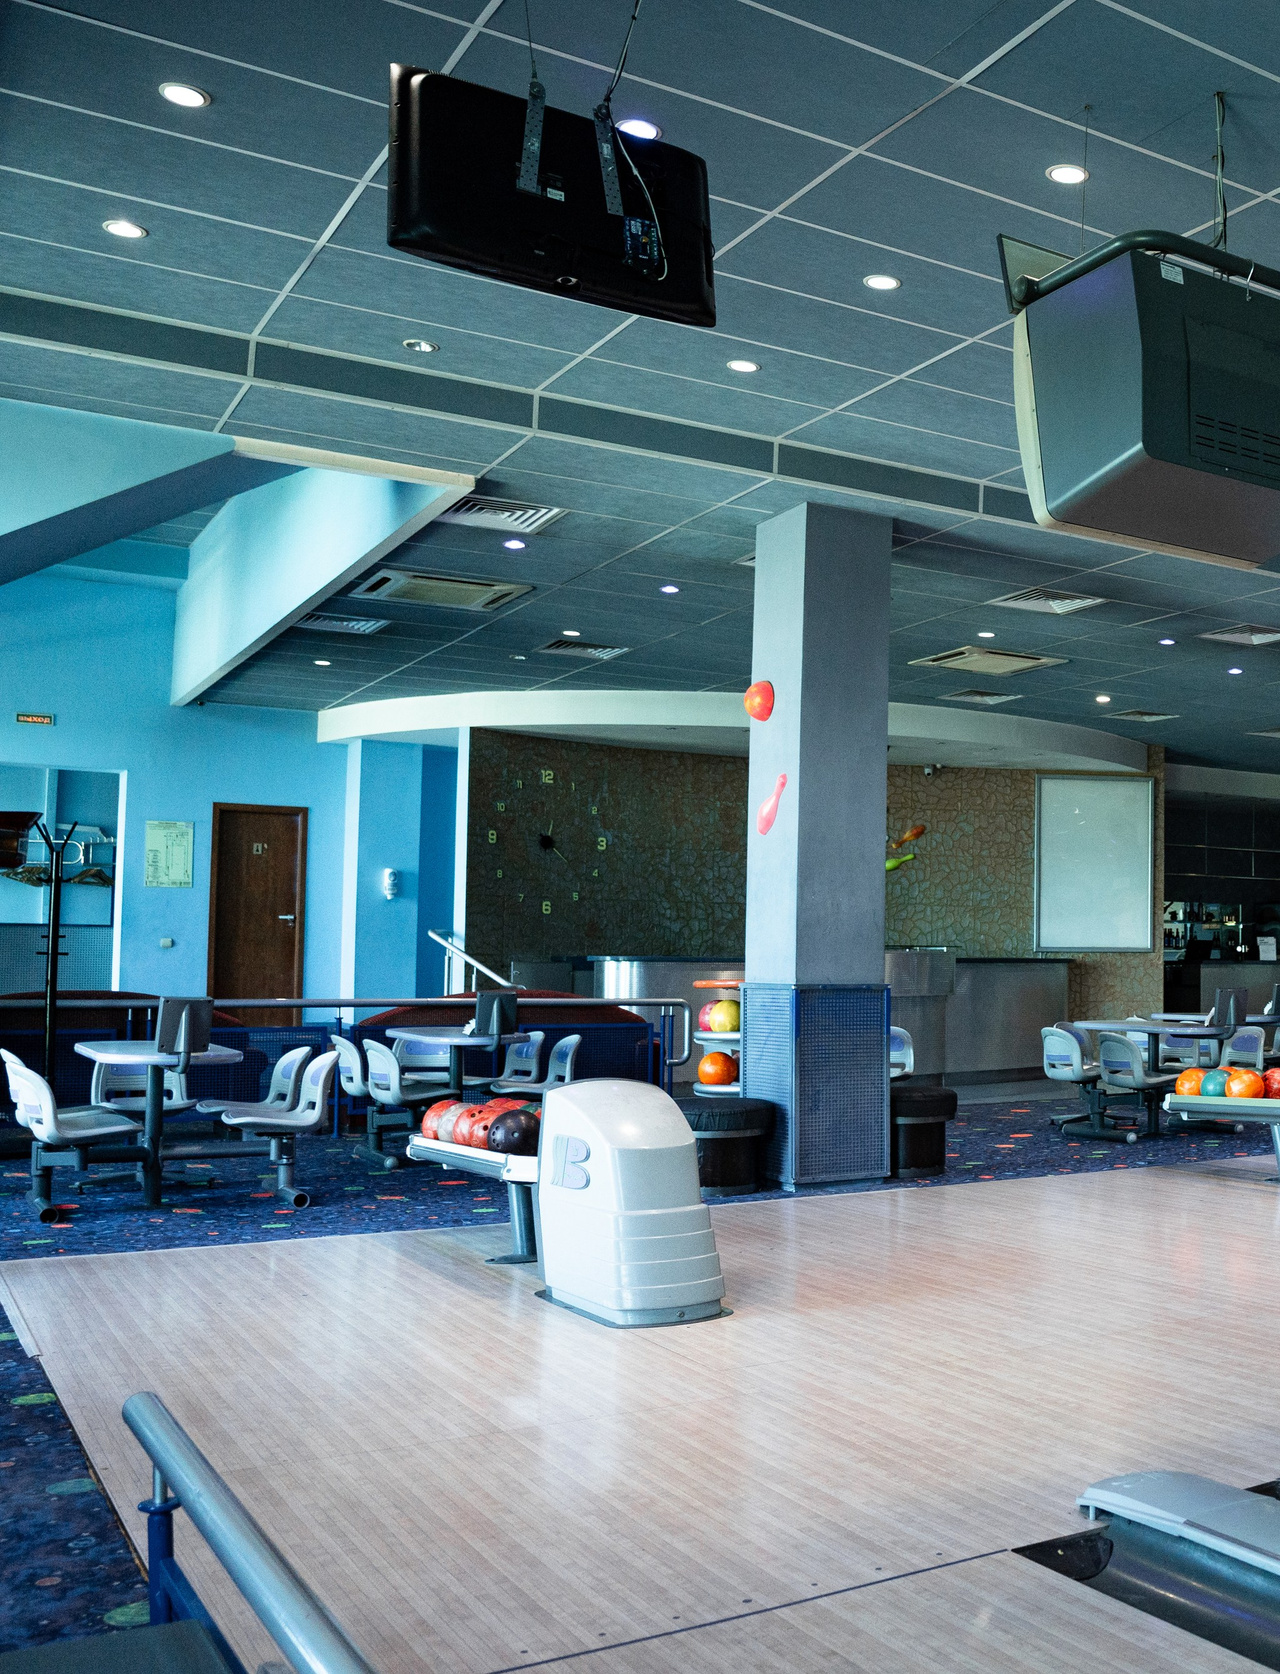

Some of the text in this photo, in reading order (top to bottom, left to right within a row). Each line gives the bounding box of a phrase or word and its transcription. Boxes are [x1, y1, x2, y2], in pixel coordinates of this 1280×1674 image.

[541, 770, 554, 784] 12
[517, 780, 523, 789] 11
[571, 782, 575, 790] 1
[497, 803, 505, 811] 10
[488, 830, 497, 844] 9
[598, 837, 607, 850] 3
[497, 870, 502, 878] 8
[518, 894, 524, 902] 7
[573, 893, 579, 901] 5
[542, 901, 551, 914] 6
